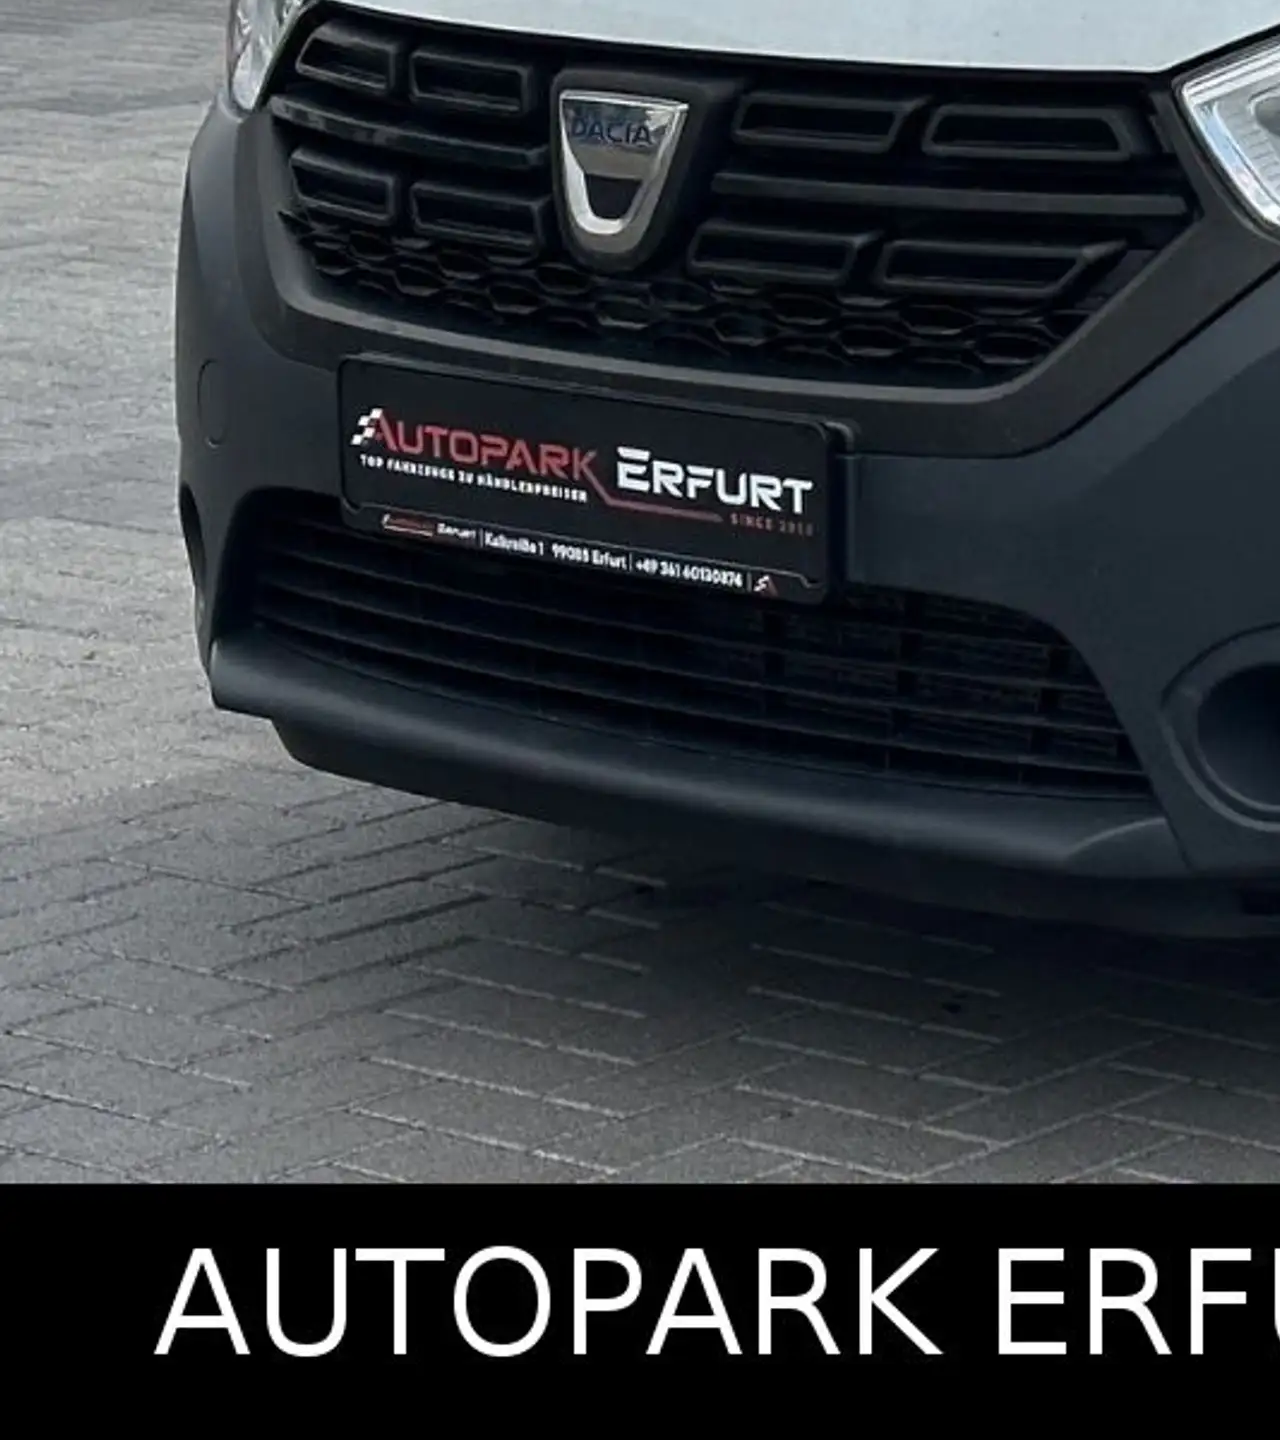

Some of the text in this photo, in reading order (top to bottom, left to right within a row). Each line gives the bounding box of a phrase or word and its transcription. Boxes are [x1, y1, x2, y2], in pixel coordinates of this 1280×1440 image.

[571, 117, 654, 147] DACIA
[351, 407, 814, 515] AUTOPARK ERFURT
